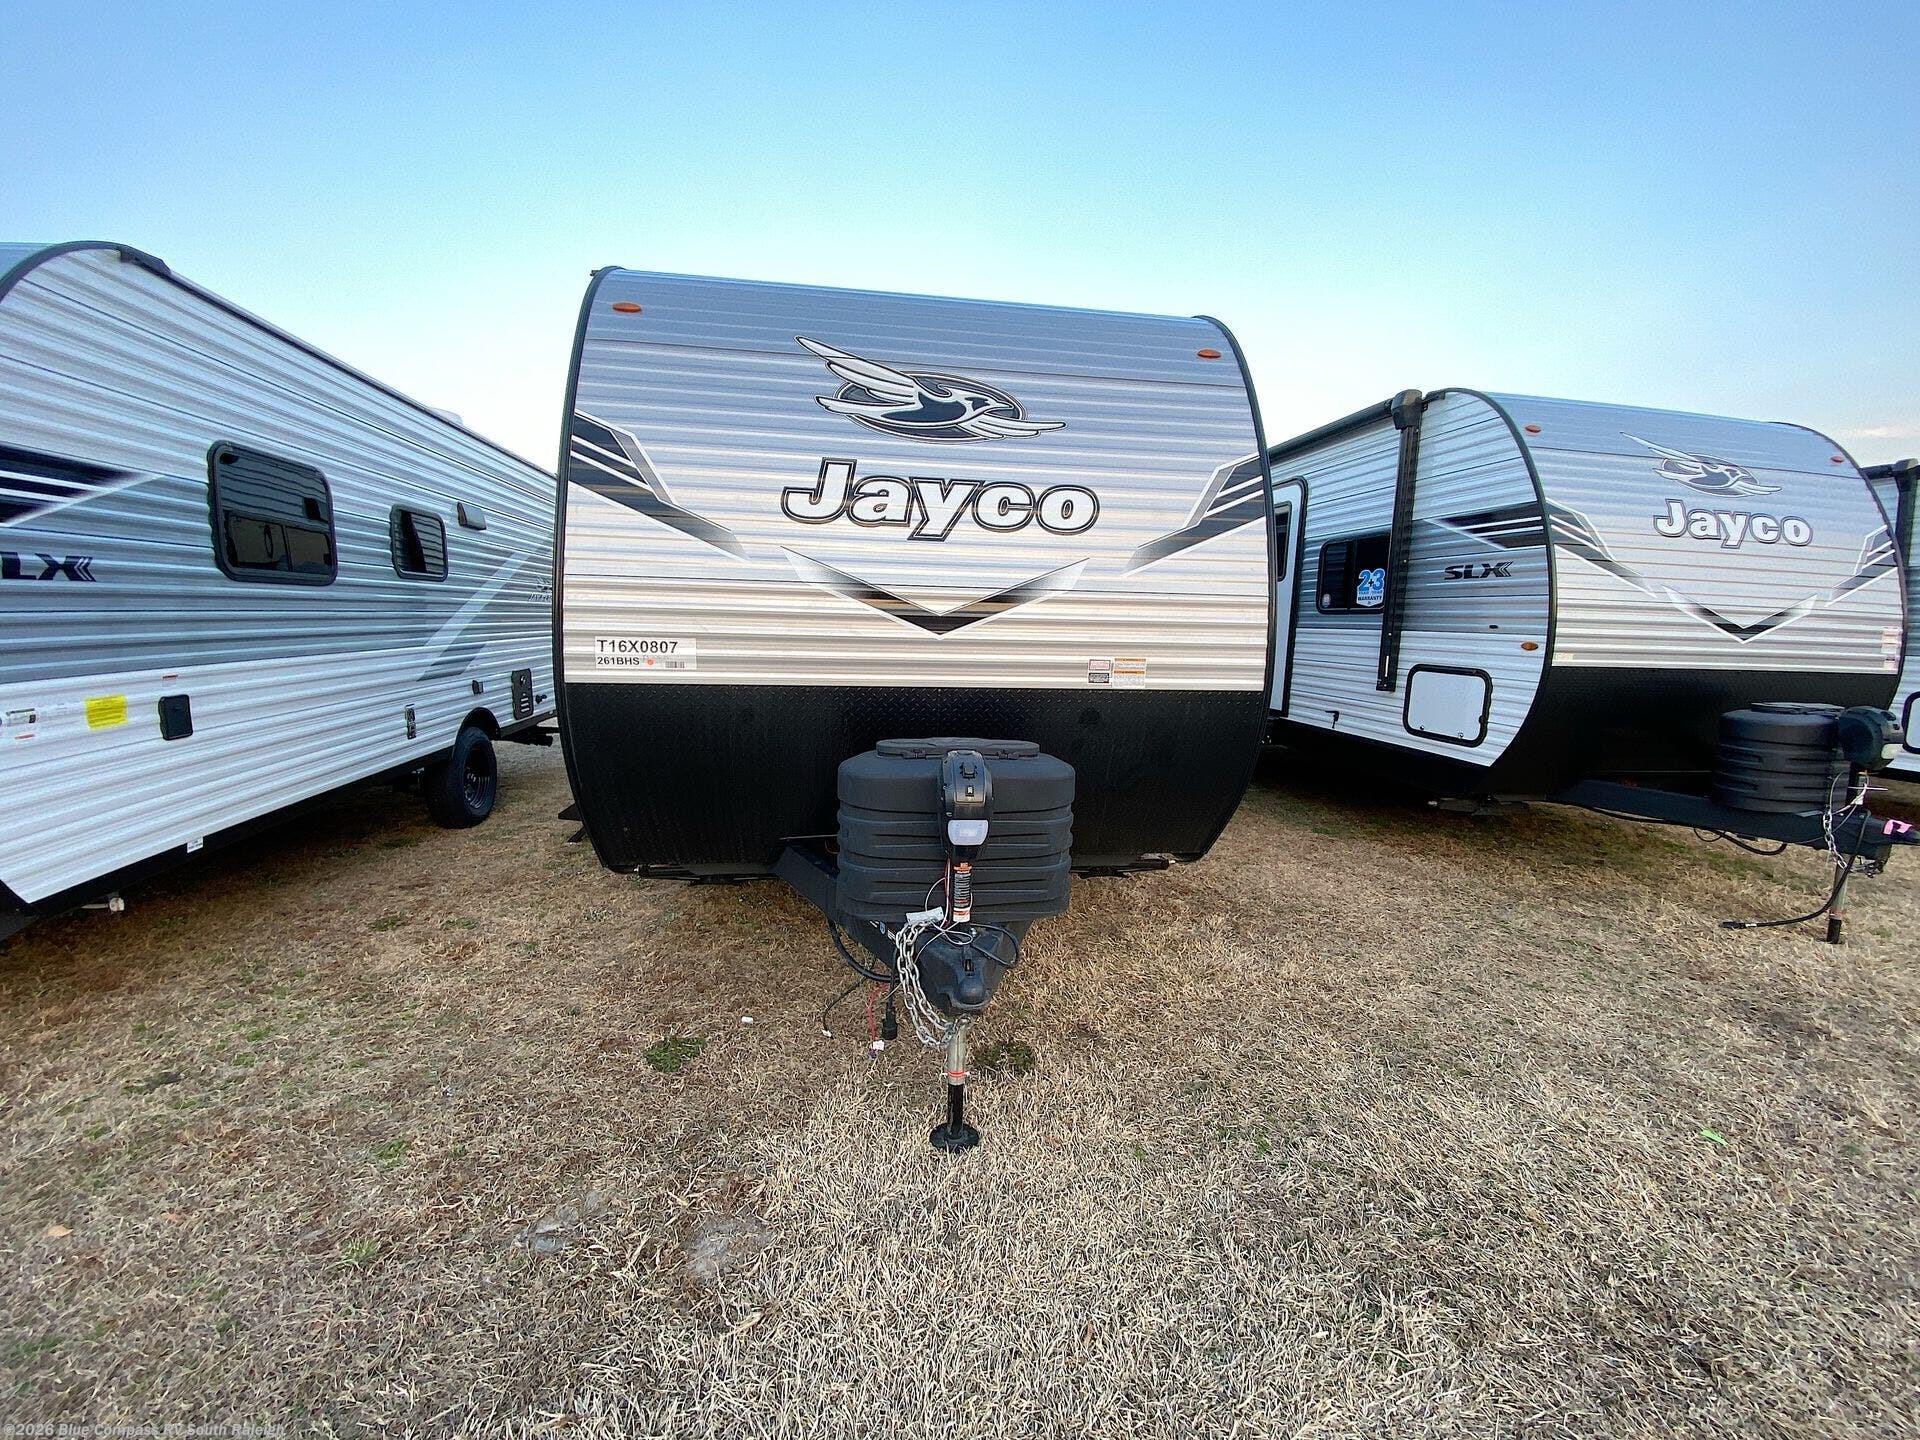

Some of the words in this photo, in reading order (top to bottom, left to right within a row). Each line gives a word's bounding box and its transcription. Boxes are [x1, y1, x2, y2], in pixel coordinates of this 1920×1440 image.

[780, 457, 1100, 541] Jayco
[1653, 498, 1813, 549] Jayco
[1443, 561, 1514, 580] SLX
[596, 639, 679, 654] T16X0807
[597, 656, 640, 666] 261BHS
